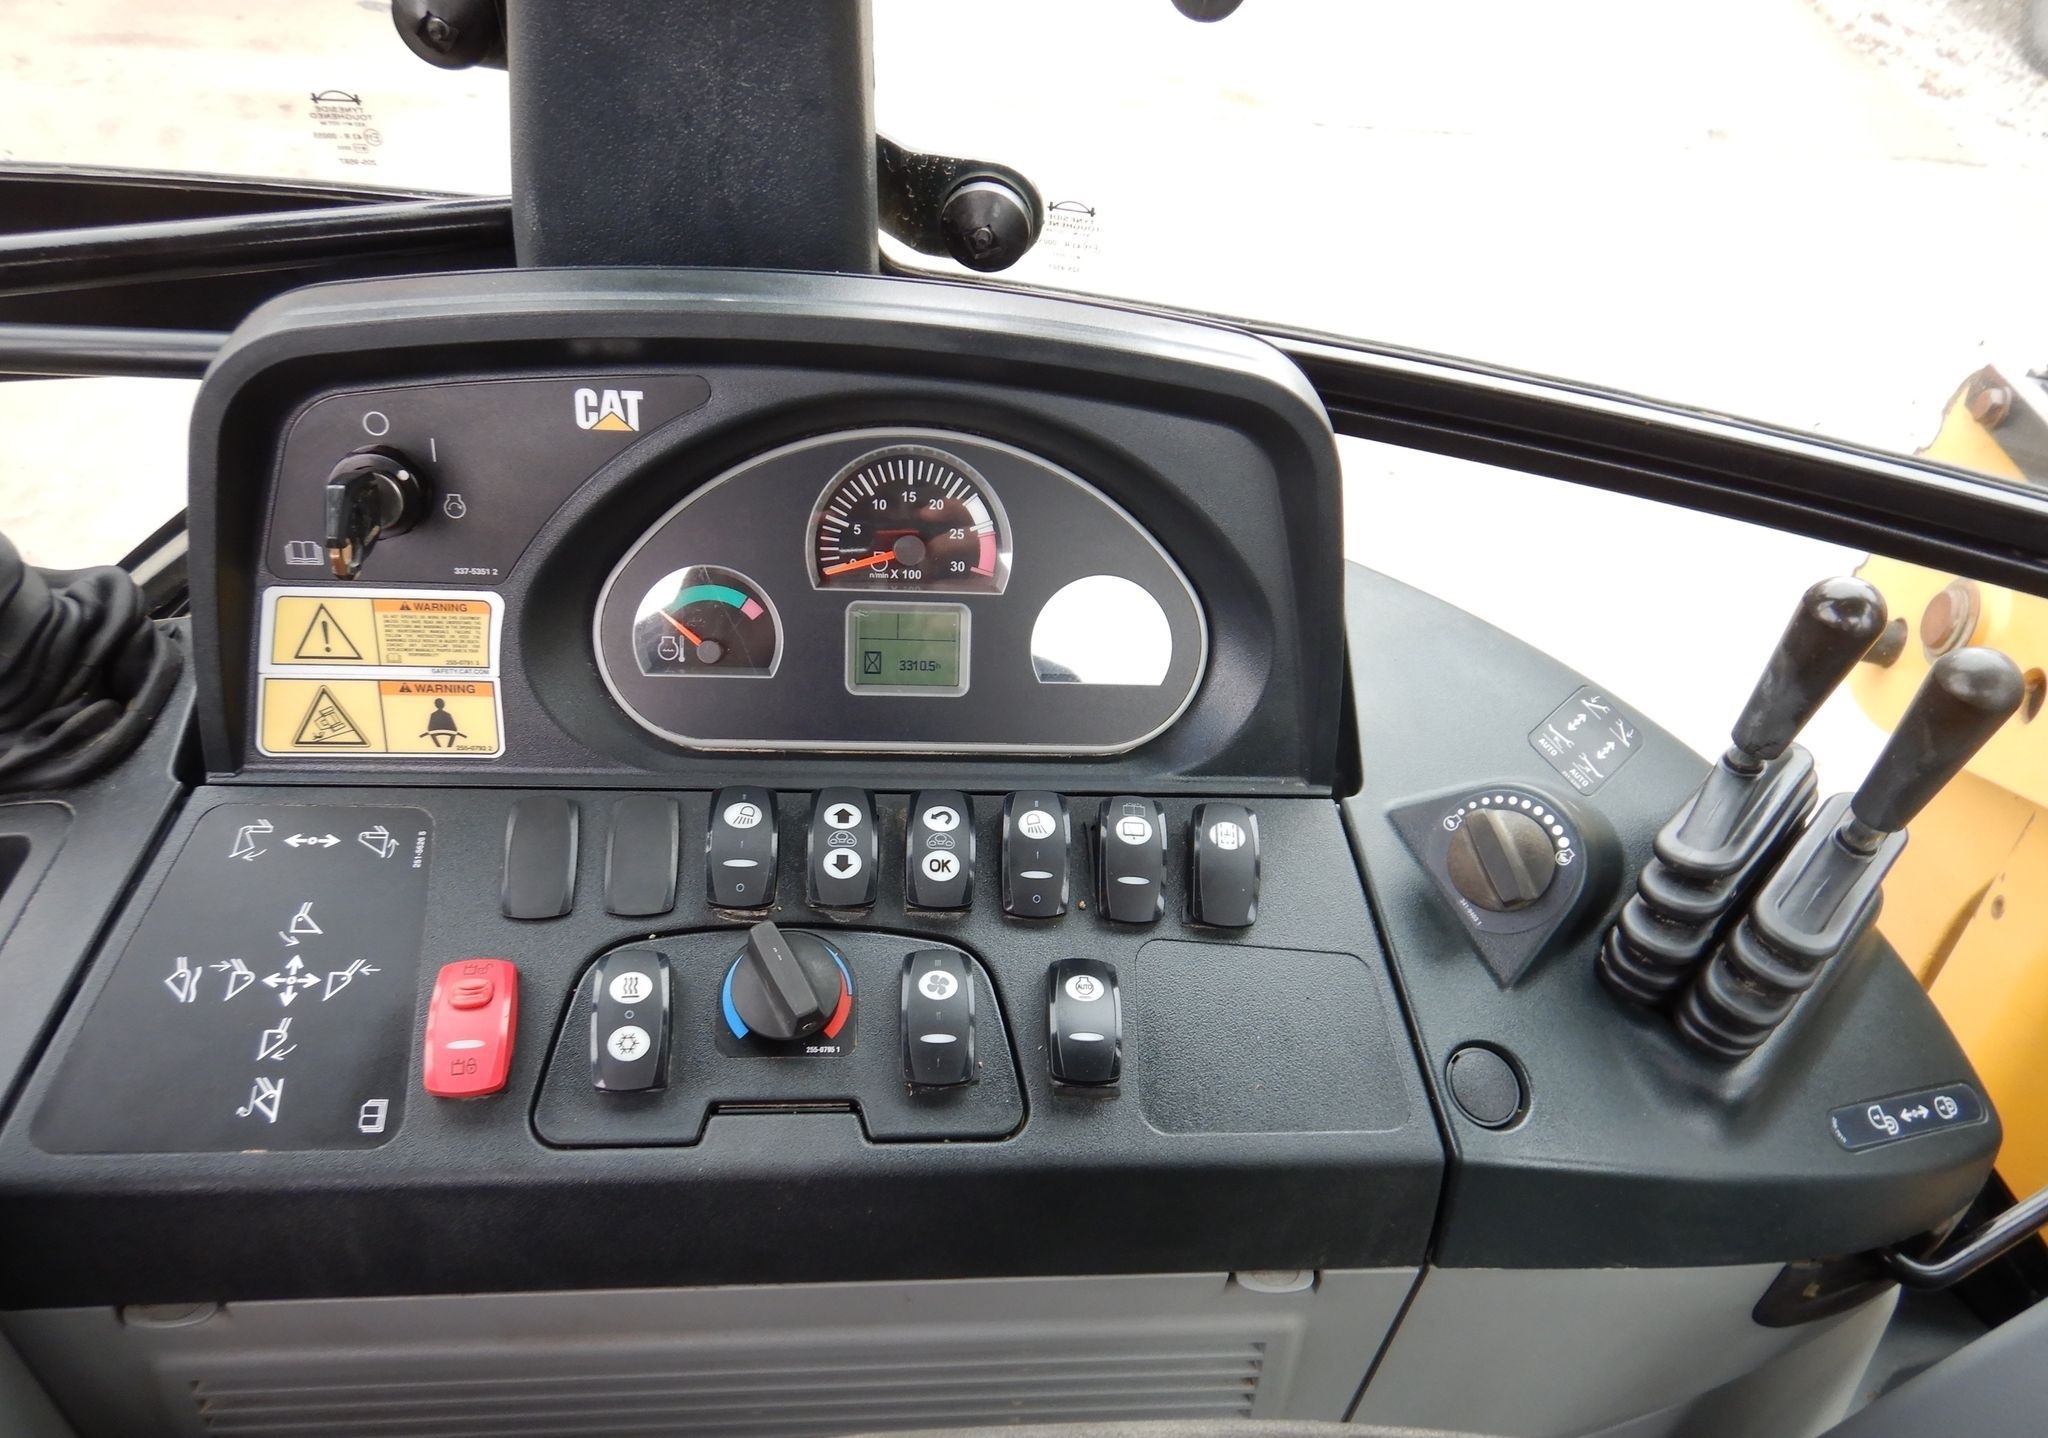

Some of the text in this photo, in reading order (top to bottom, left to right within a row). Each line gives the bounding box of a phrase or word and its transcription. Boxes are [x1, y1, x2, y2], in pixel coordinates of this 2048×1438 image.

[574, 388, 644, 432] CAT
[901, 492, 917, 502] 15
[872, 499, 887, 510] 10
[929, 499, 944, 510] 20
[853, 524, 861, 535] 5
[949, 529, 965, 540] 25
[491, 568, 499, 576] 2
[950, 561, 965, 572] 30
[902, 569, 922, 580] 100
[413, 602, 468, 612] WARNING
[414, 684, 476, 694] WARNING
[1538, 738, 1558, 756] AUTO
[1569, 768, 1589, 787] AUTO
[929, 859, 952, 873] OK
